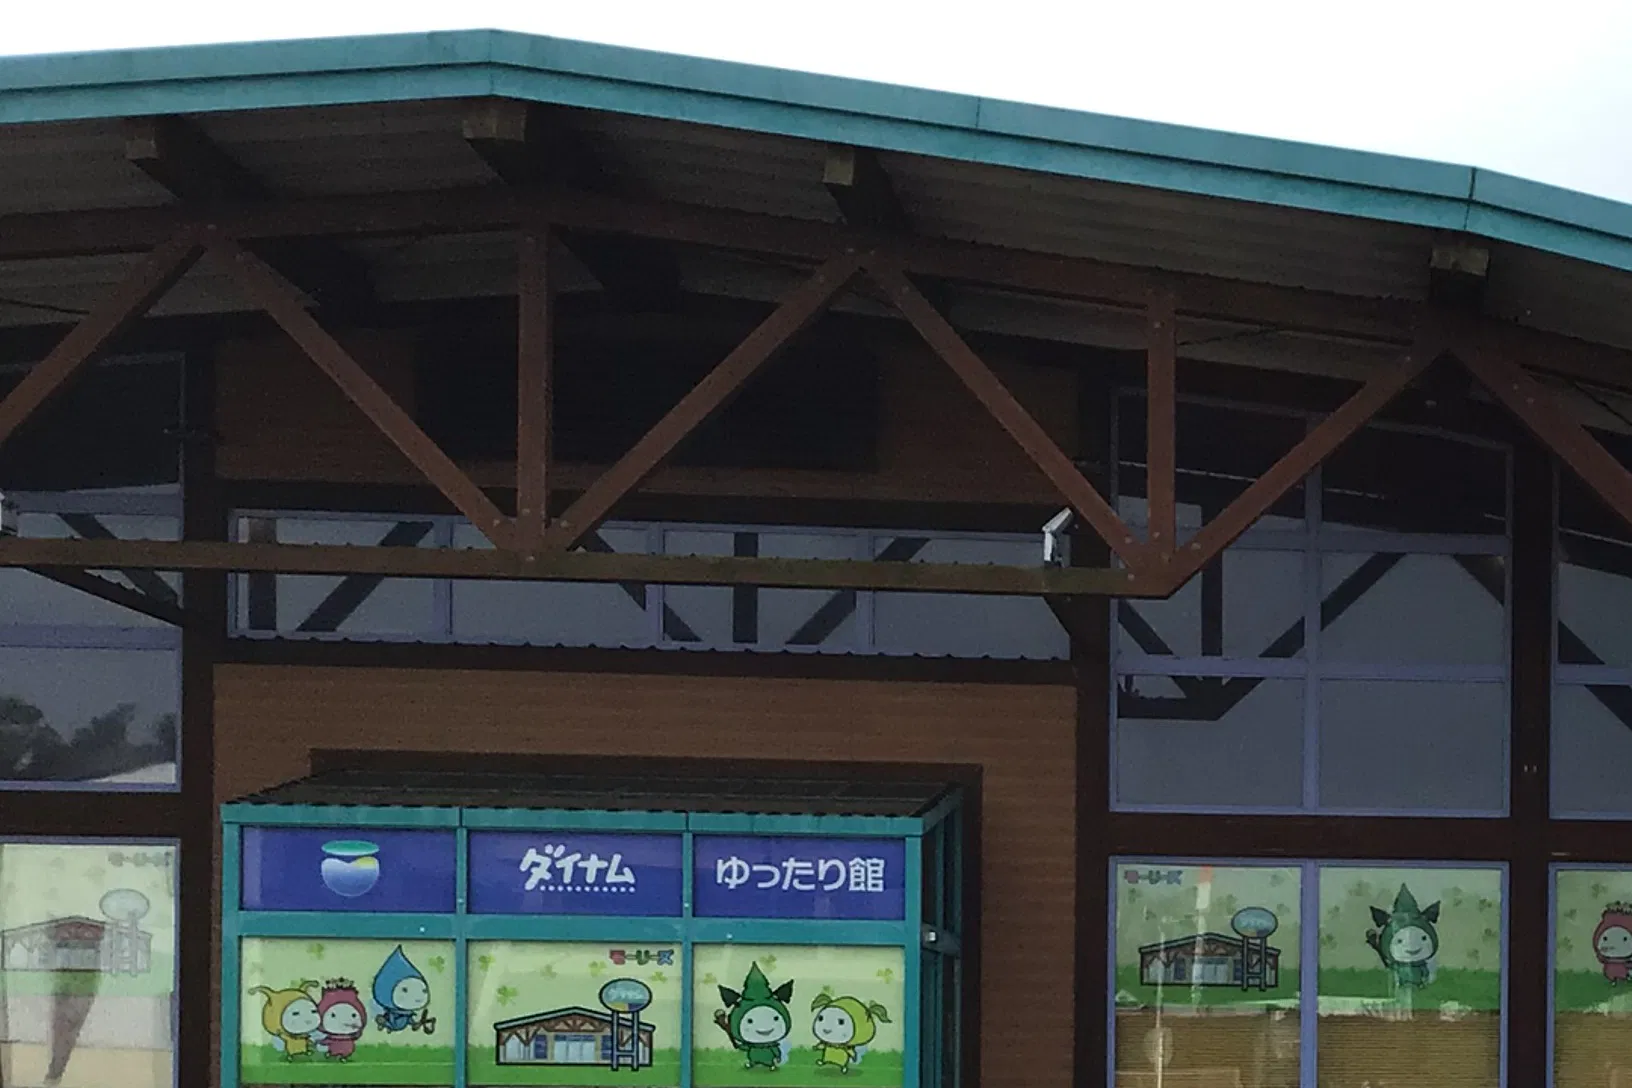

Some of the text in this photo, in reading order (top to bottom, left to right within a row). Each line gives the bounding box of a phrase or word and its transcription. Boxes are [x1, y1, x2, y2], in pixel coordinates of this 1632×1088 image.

[519, 844, 636, 892] ダイナム
[716, 856, 885, 892] ゆったり館
